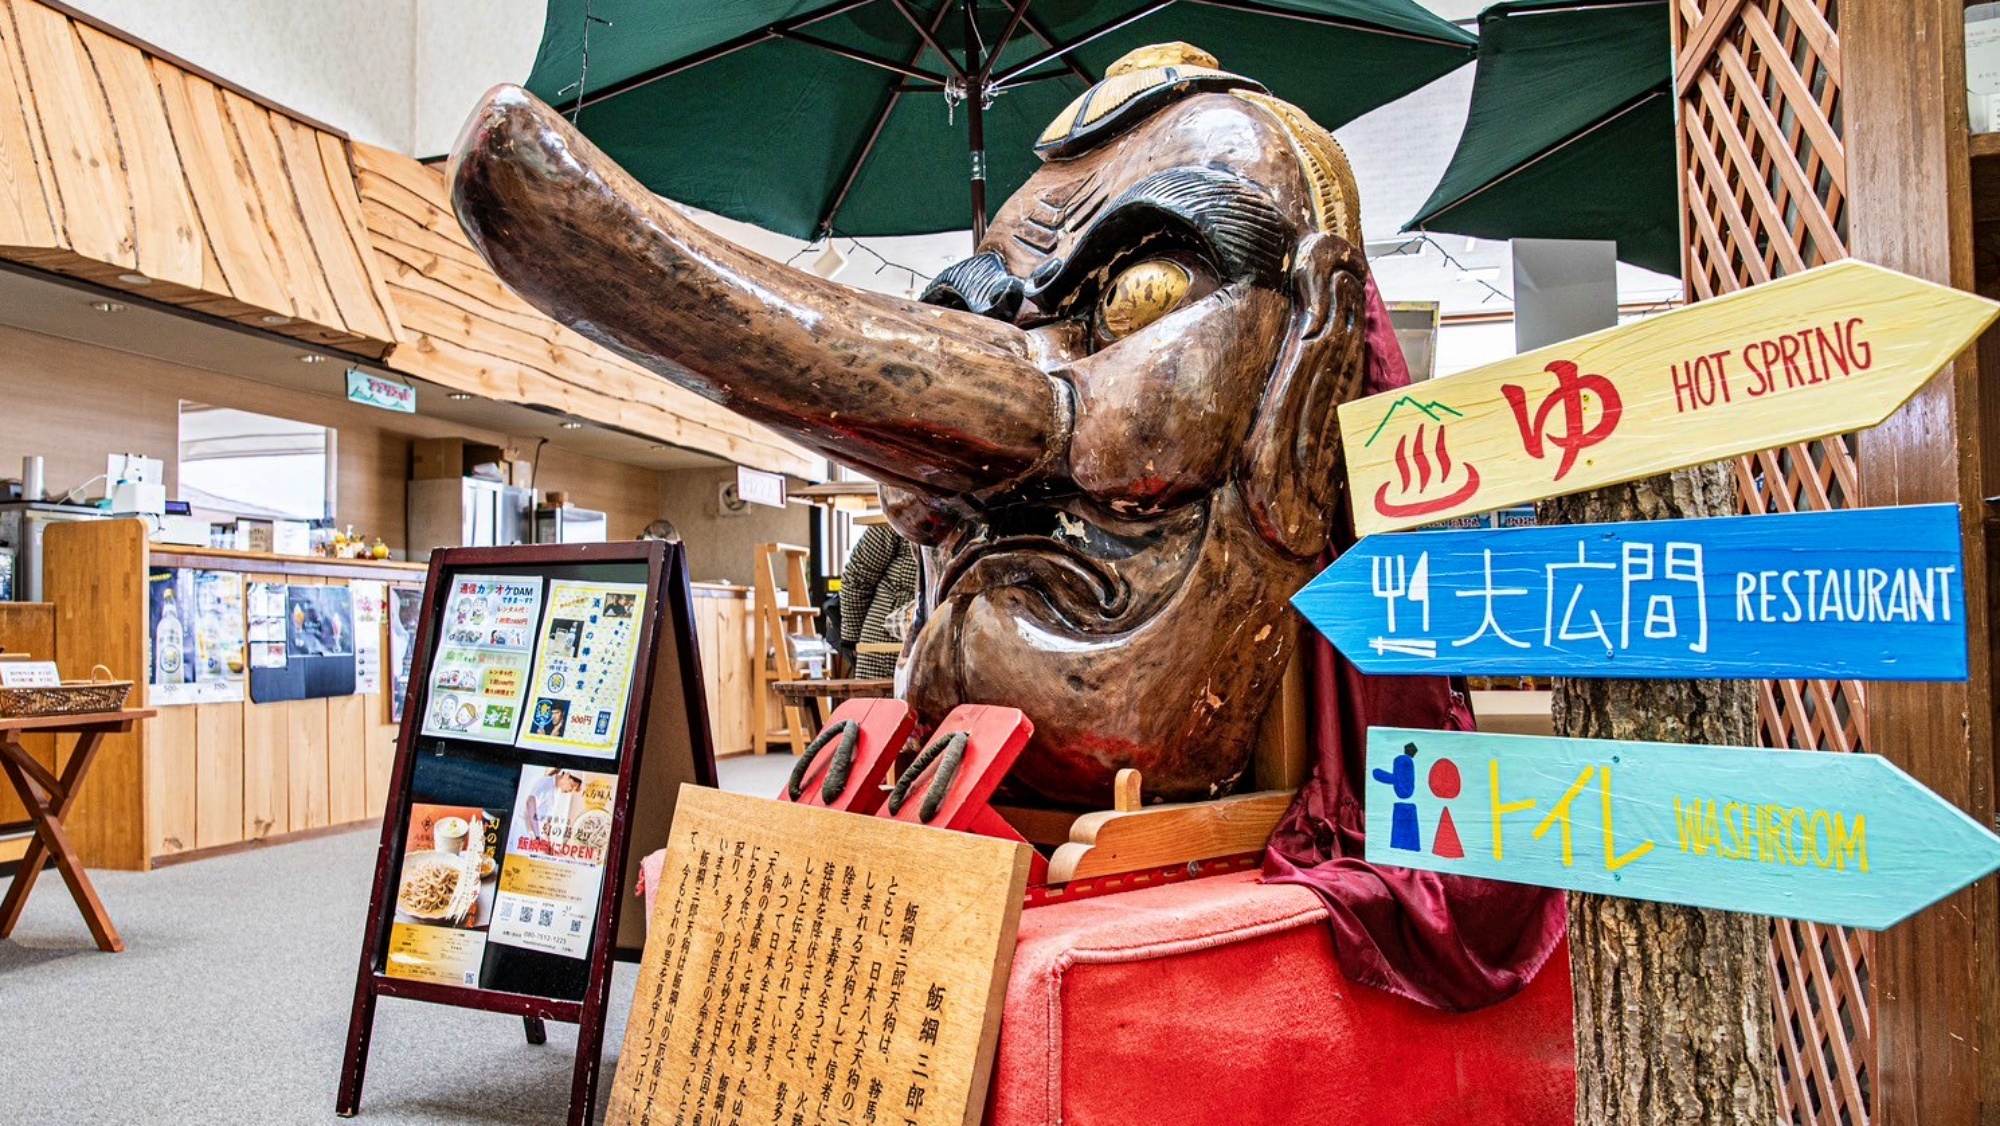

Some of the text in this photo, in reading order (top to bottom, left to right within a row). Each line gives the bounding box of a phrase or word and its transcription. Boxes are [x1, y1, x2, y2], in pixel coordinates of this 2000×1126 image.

[1500, 359, 1622, 481] ゆ
[1671, 317, 1872, 412] HOT SPRING
[1451, 541, 1707, 652] 大広間
[1735, 566, 1956, 624] RESTAURANT
[570, 714, 593, 726] 500円
[712, 838, 728, 895] います。
[1488, 758, 1654, 871] トイレ
[1672, 794, 1870, 873] WASHROOM
[765, 857, 814, 1082] したと伝えられています。
[772, 862, 835, 1126] 強敵を降伏させるなど、数多
[813, 872, 874, 1126] しまれる天狗として信者に
[863, 902, 919, 1126] 飯綱三郎天狗は、鞍馬
[904, 983, 946, 1126] 飯綱三郎
